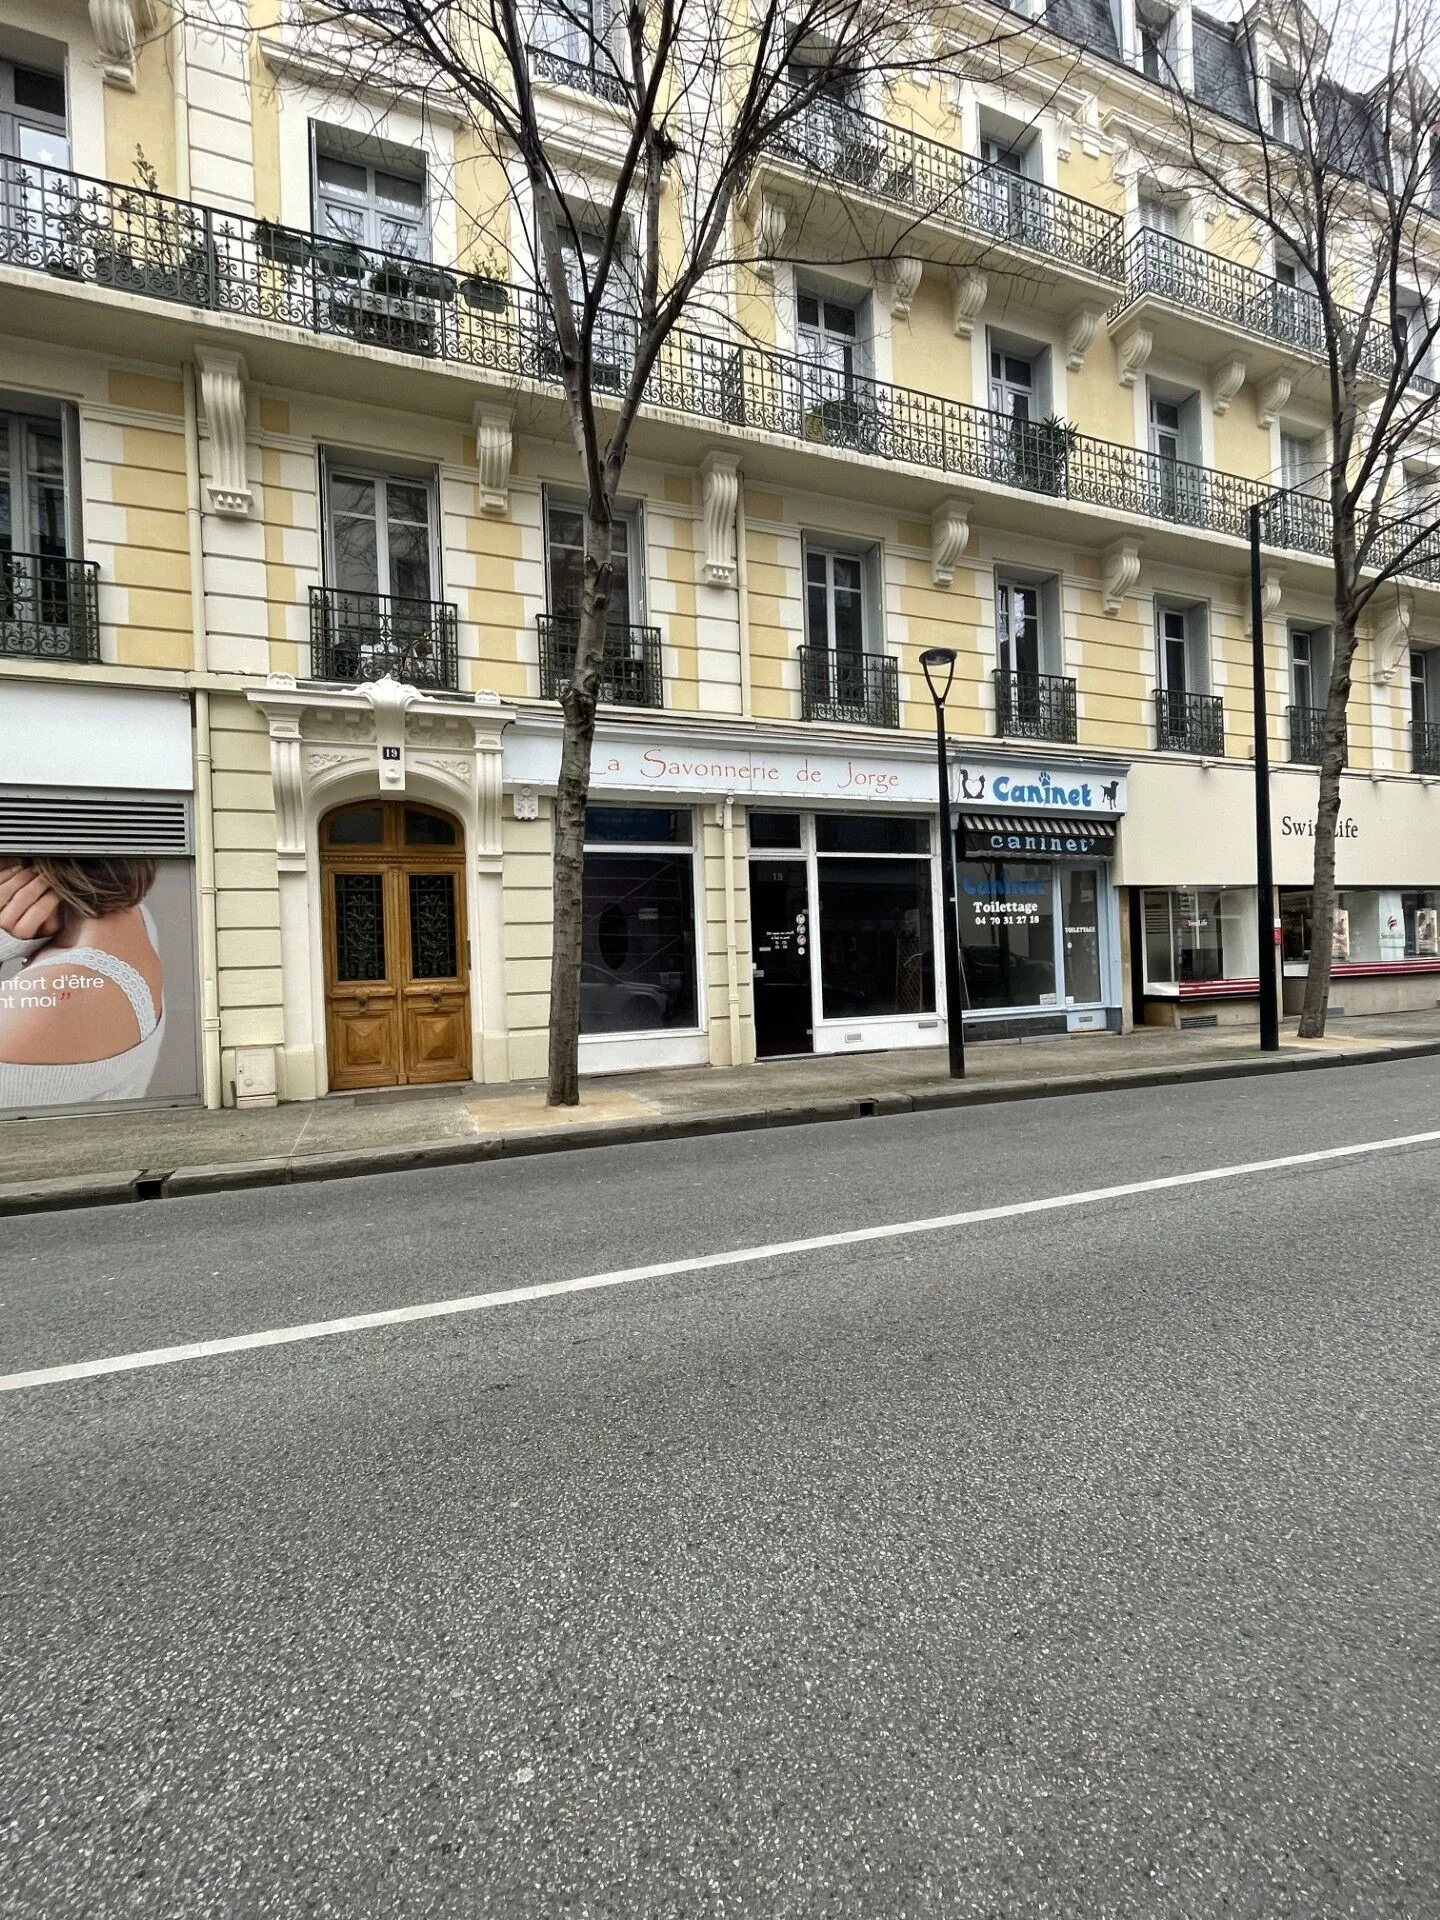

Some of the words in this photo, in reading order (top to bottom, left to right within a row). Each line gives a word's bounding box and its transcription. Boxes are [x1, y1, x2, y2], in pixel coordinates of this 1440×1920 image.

[386, 748, 398, 758] 19
[640, 748, 780, 780] Savonnerie
[796, 760, 822, 783] de
[837, 761, 899, 793] Jorge
[993, 776, 1092, 807] Caninet
[972, 901, 1038, 914] Toilettage
[975, 917, 986, 925] 04
[990, 917, 1000, 925] 70
[1003, 916, 1013, 924] 31
[1016, 916, 1027, 924] 27
[53, 974, 104, 990] d'être
